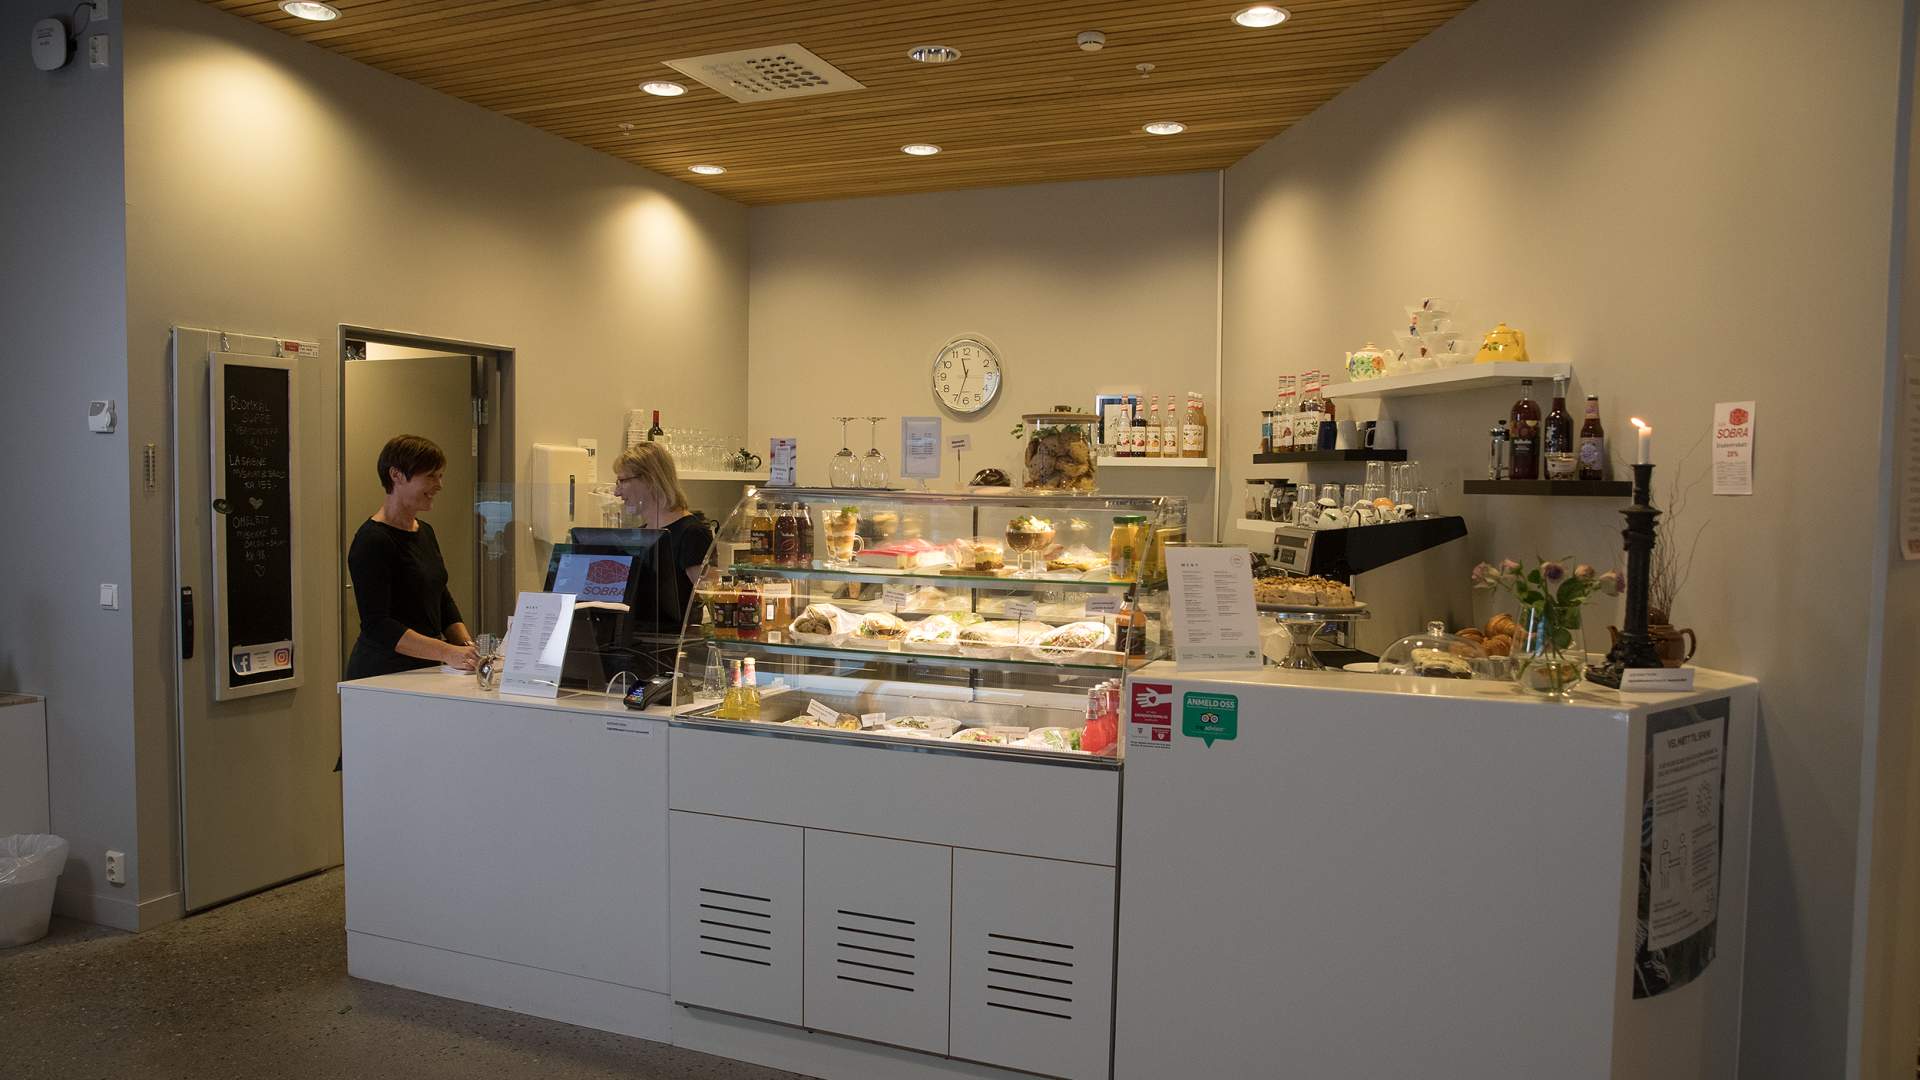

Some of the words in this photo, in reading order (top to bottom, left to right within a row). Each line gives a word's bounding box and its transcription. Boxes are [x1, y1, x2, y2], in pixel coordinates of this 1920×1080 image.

[952, 351, 958, 359] 11
[963, 348, 971, 356] 12
[943, 361, 952, 369] 10
[983, 360, 990, 368] 2
[940, 373, 947, 381] 9
[986, 372, 992, 380] 3
[943, 384, 950, 393] 8
[983, 384, 989, 392] 4
[952, 393, 959, 402] 7
[962, 397, 970, 405] 6
[974, 393, 981, 401] 5
[1717, 427, 1748, 439] SOBRA
[1187, 697, 1219, 707] ANMELD
[1219, 700, 1236, 709] OSS
